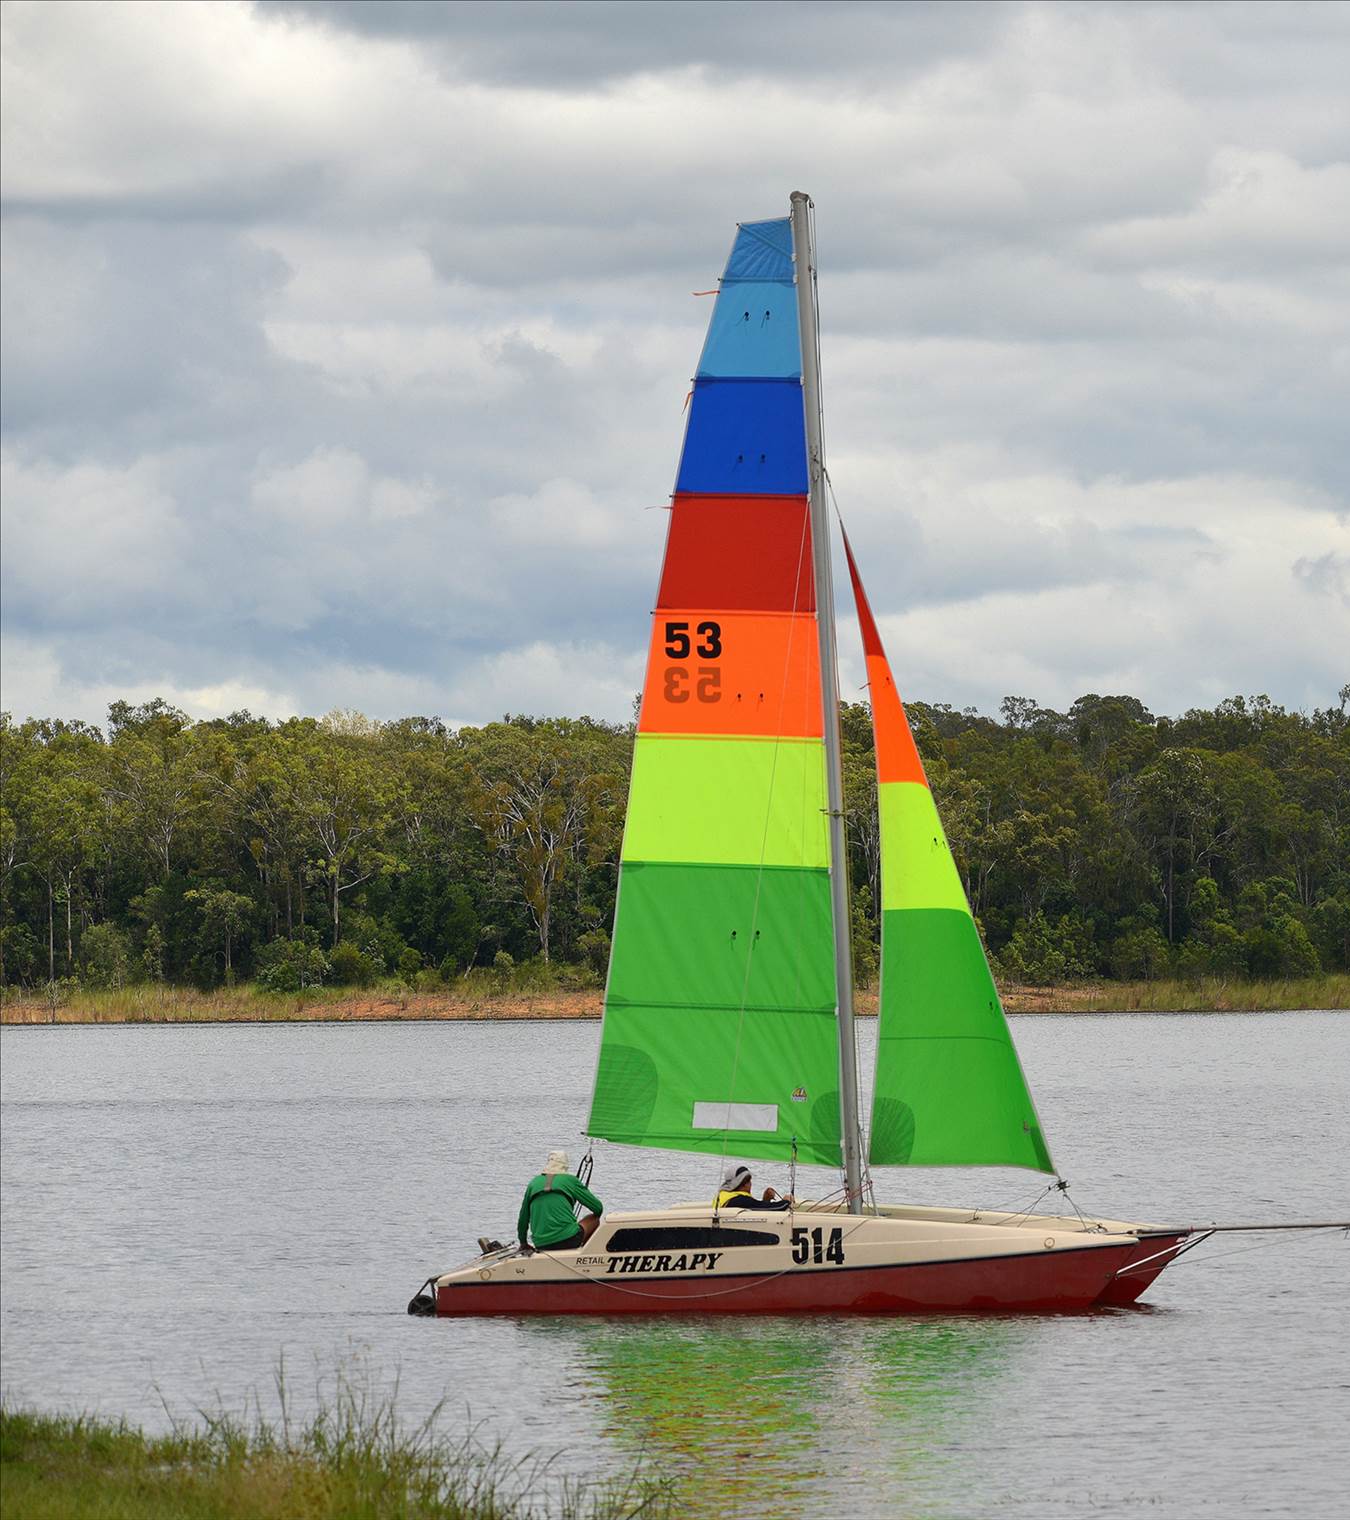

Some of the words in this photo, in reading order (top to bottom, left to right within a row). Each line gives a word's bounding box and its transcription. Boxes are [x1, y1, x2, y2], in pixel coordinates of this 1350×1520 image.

[665, 622, 722, 659] 53
[576, 1257, 605, 1265] RETAIL
[606, 1253, 723, 1273] THERAPY
[792, 1227, 845, 1265] 514
